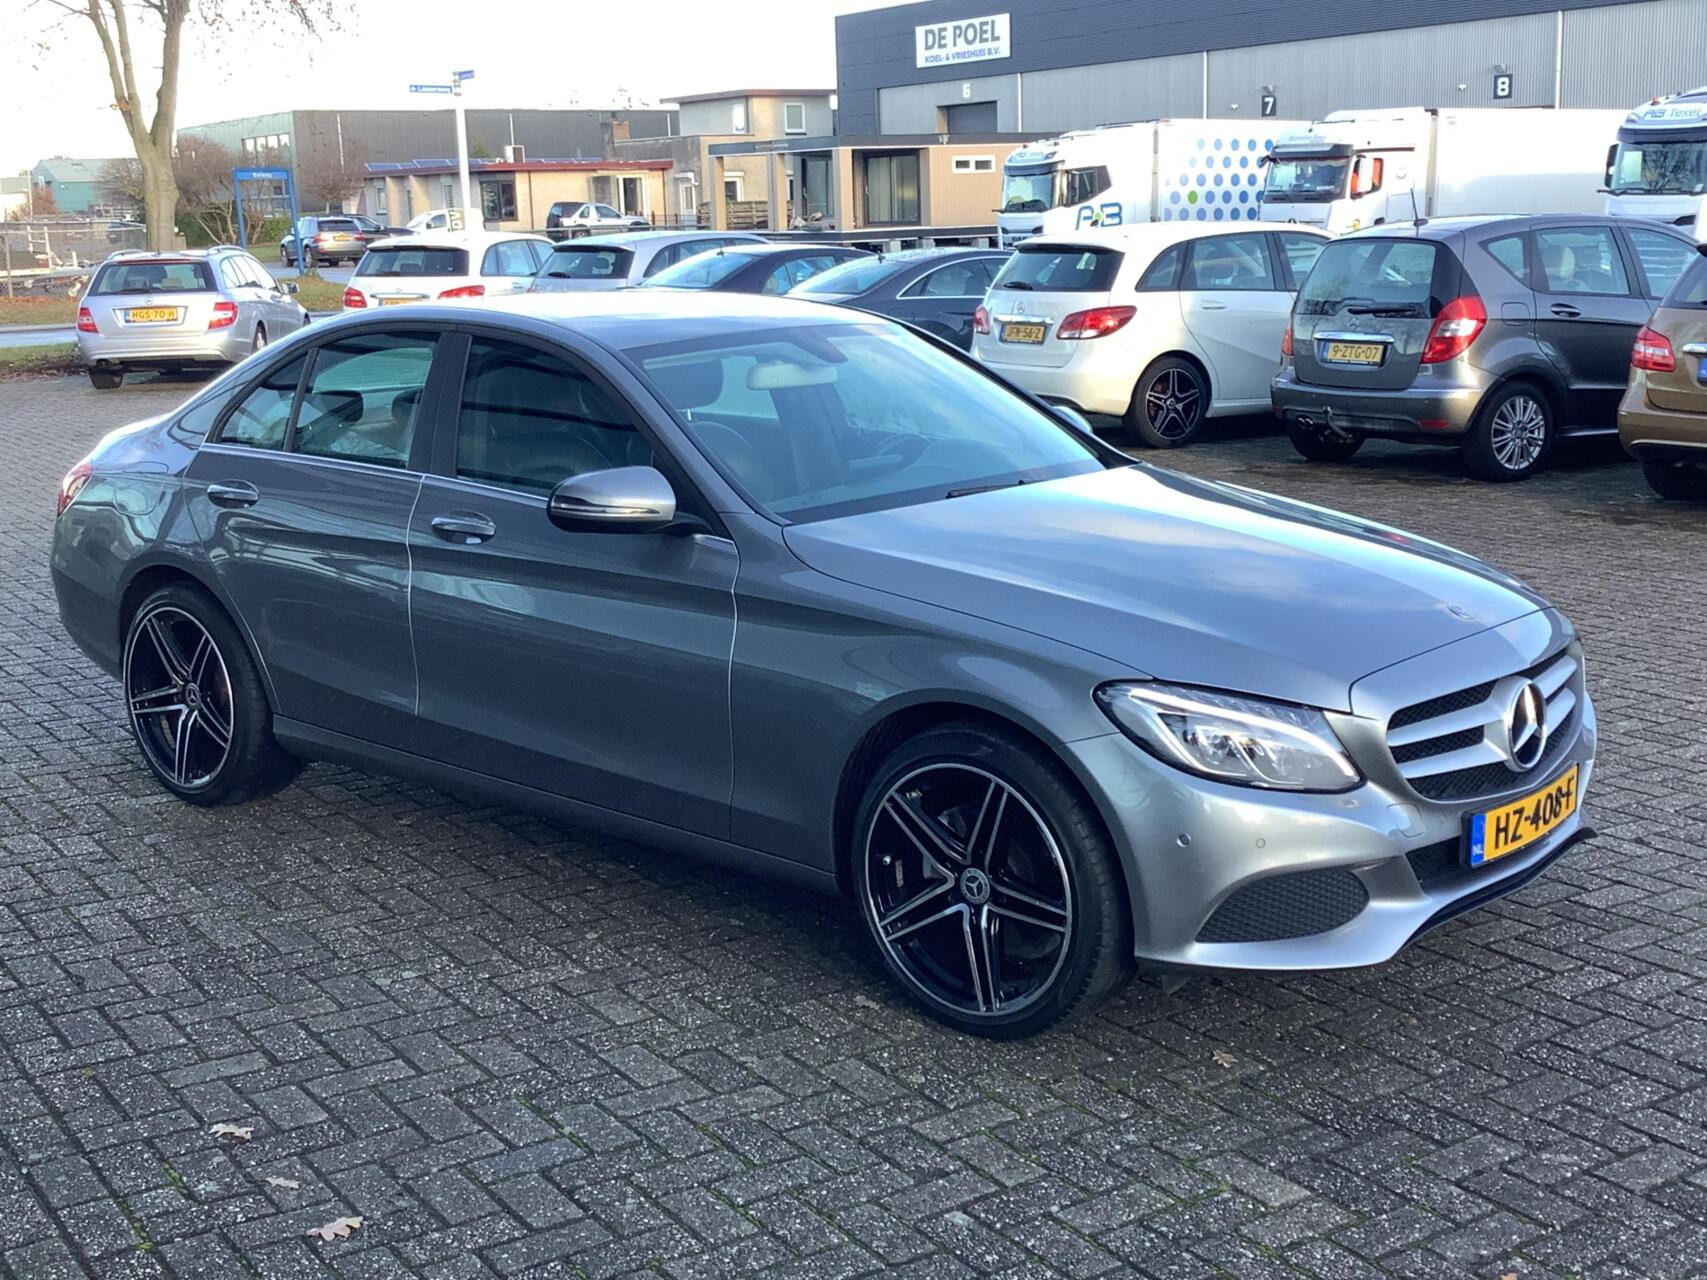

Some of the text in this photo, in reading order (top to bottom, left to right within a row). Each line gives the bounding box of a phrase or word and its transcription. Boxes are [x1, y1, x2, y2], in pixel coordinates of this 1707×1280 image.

[924, 20, 1000, 50] DE POEL
[952, 48, 986, 60] VRIESHUIS
[987, 47, 1001, 56] B.V.
[963, 84, 970, 98] 6
[1497, 77, 1510, 96] 8
[1264, 97, 1274, 114] 7
[1670, 108, 1701, 118] Texel
[1332, 345, 1379, 359] 9-ZTG-07
[1494, 776, 1574, 850] HZ-408-F
[1472, 844, 1483, 856] NL
